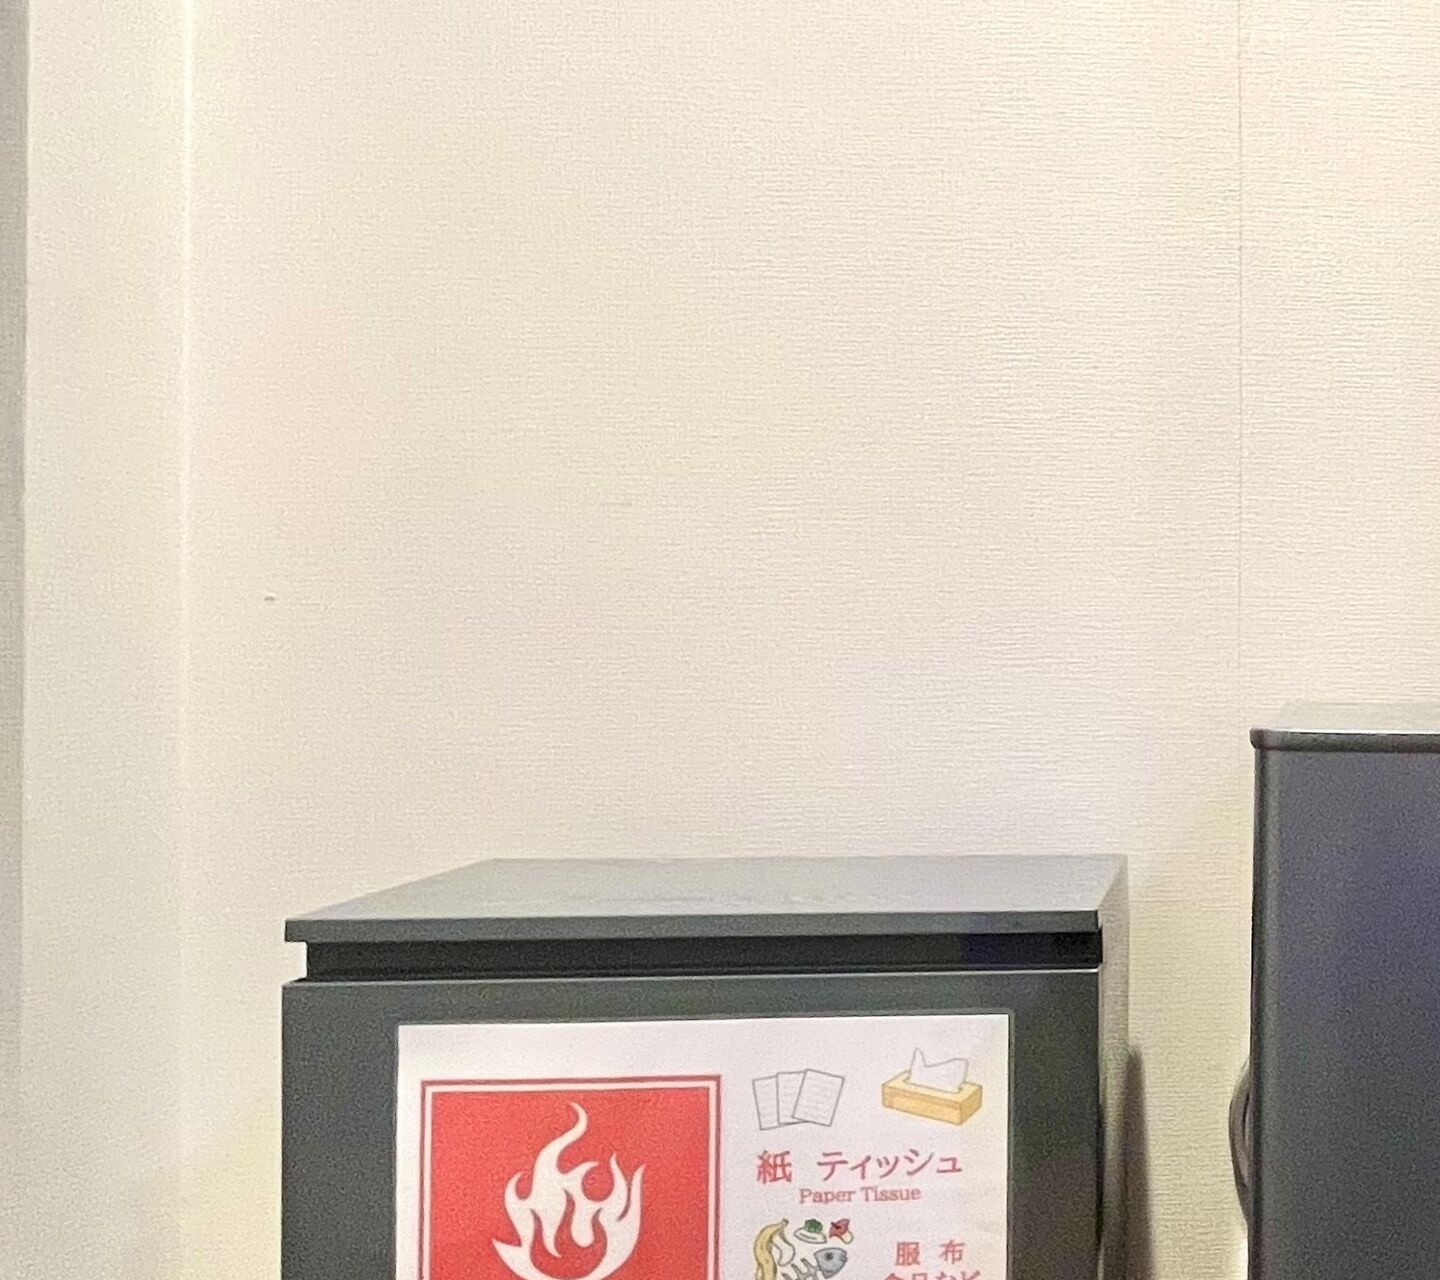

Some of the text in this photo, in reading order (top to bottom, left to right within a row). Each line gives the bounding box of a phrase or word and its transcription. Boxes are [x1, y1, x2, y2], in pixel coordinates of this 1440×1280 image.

[757, 1148, 962, 1184] 紙 ティッシュ
[799, 1185, 922, 1205] Paper Tissue
[895, 1239, 966, 1266] 服 布
